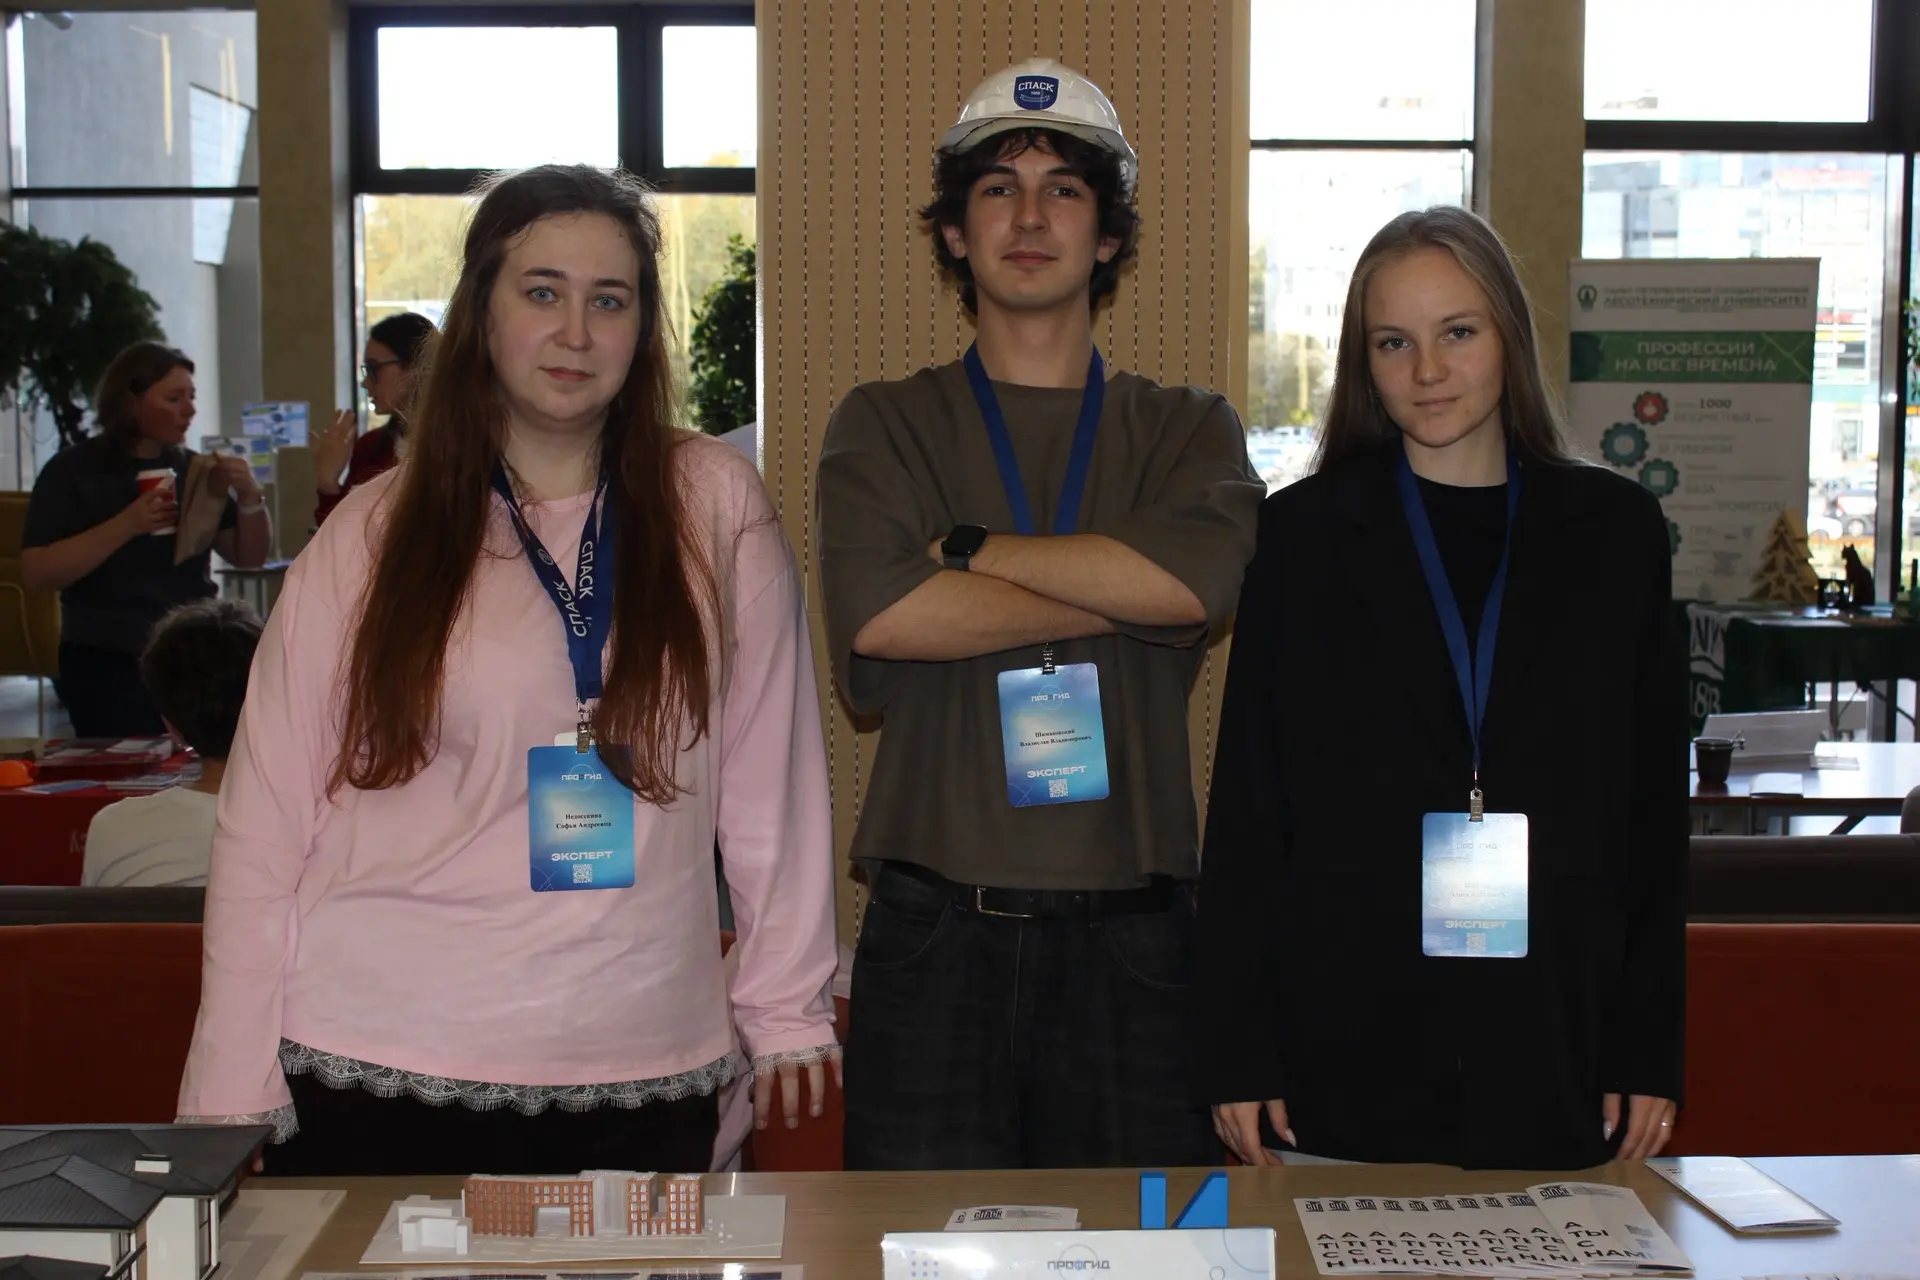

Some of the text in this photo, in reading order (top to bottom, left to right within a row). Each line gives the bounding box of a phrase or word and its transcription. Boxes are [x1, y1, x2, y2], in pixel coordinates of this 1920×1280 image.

[1018, 81, 1055, 92] СПАСК
[1637, 341, 1755, 356] ПРОФЕССИИ
[1615, 358, 1777, 372] НА ВСЕ ВРЕМЕНА
[1700, 398, 1732, 409] 1000
[578, 540, 594, 598] СПАСК
[553, 581, 586, 637] СПАСК
[1026, 765, 1088, 778] ЭКСПЕРТ
[556, 822, 576, 830] Софья
[551, 850, 614, 862] ЭКСПЕРТ
[1444, 920, 1508, 929] ЭКСПЕРТ
[1540, 1187, 1570, 1198] СПАСК
[973, 1210, 1004, 1220] СПАСК
[1564, 1221, 1582, 1230] А
[1368, 1230, 1386, 1238] А
[1503, 1227, 1520, 1235] А
[1568, 1230, 1610, 1238] ТЫ
[1512, 1244, 1530, 1252] С
[1542, 1244, 1560, 1252] С
[1576, 1240, 1595, 1248] С
[1348, 1248, 1364, 1256] С
[1489, 1246, 1507, 1254] С
[1047, 1260, 1110, 1270] ПРОФГИД
